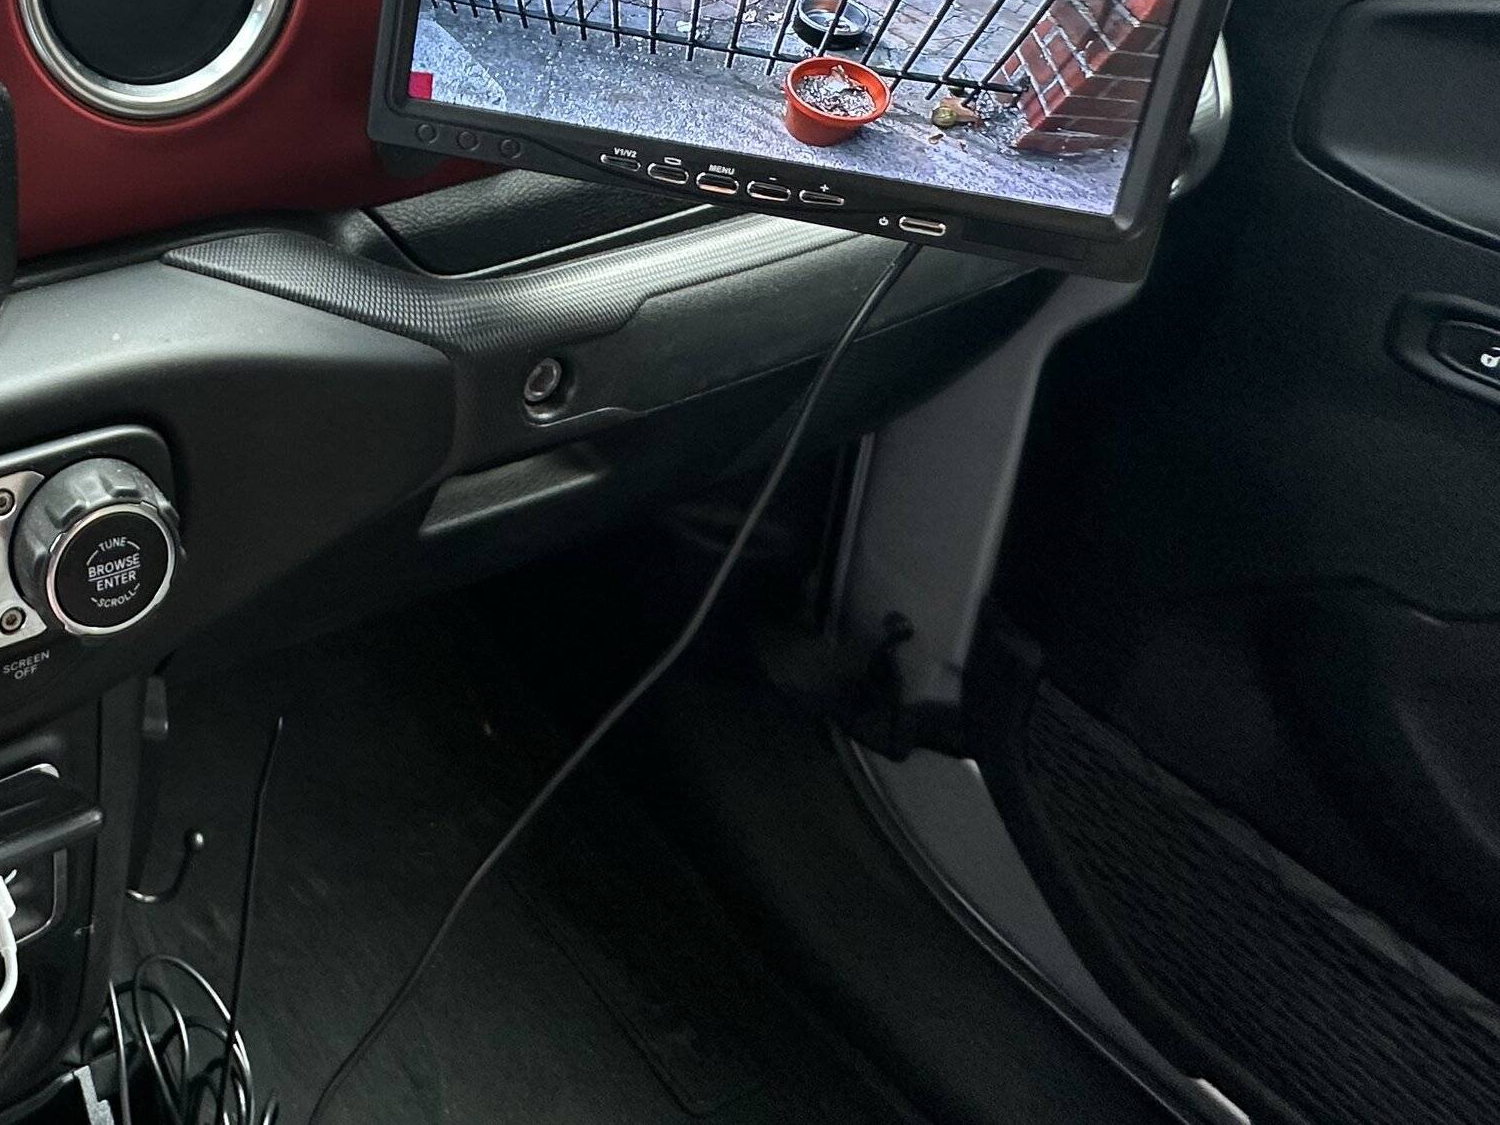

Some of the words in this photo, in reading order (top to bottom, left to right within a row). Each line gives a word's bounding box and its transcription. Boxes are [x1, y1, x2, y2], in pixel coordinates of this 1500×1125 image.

[613, 147, 638, 158] V1/V2
[708, 163, 736, 176] MENU
[98, 536, 128, 552] TUNE
[88, 553, 141, 578] BROWSE
[96, 570, 137, 592] ENTER
[97, 589, 137, 608] SCROLL
[2, 649, 51, 676] SCREEN
[13, 663, 39, 681] OFF
